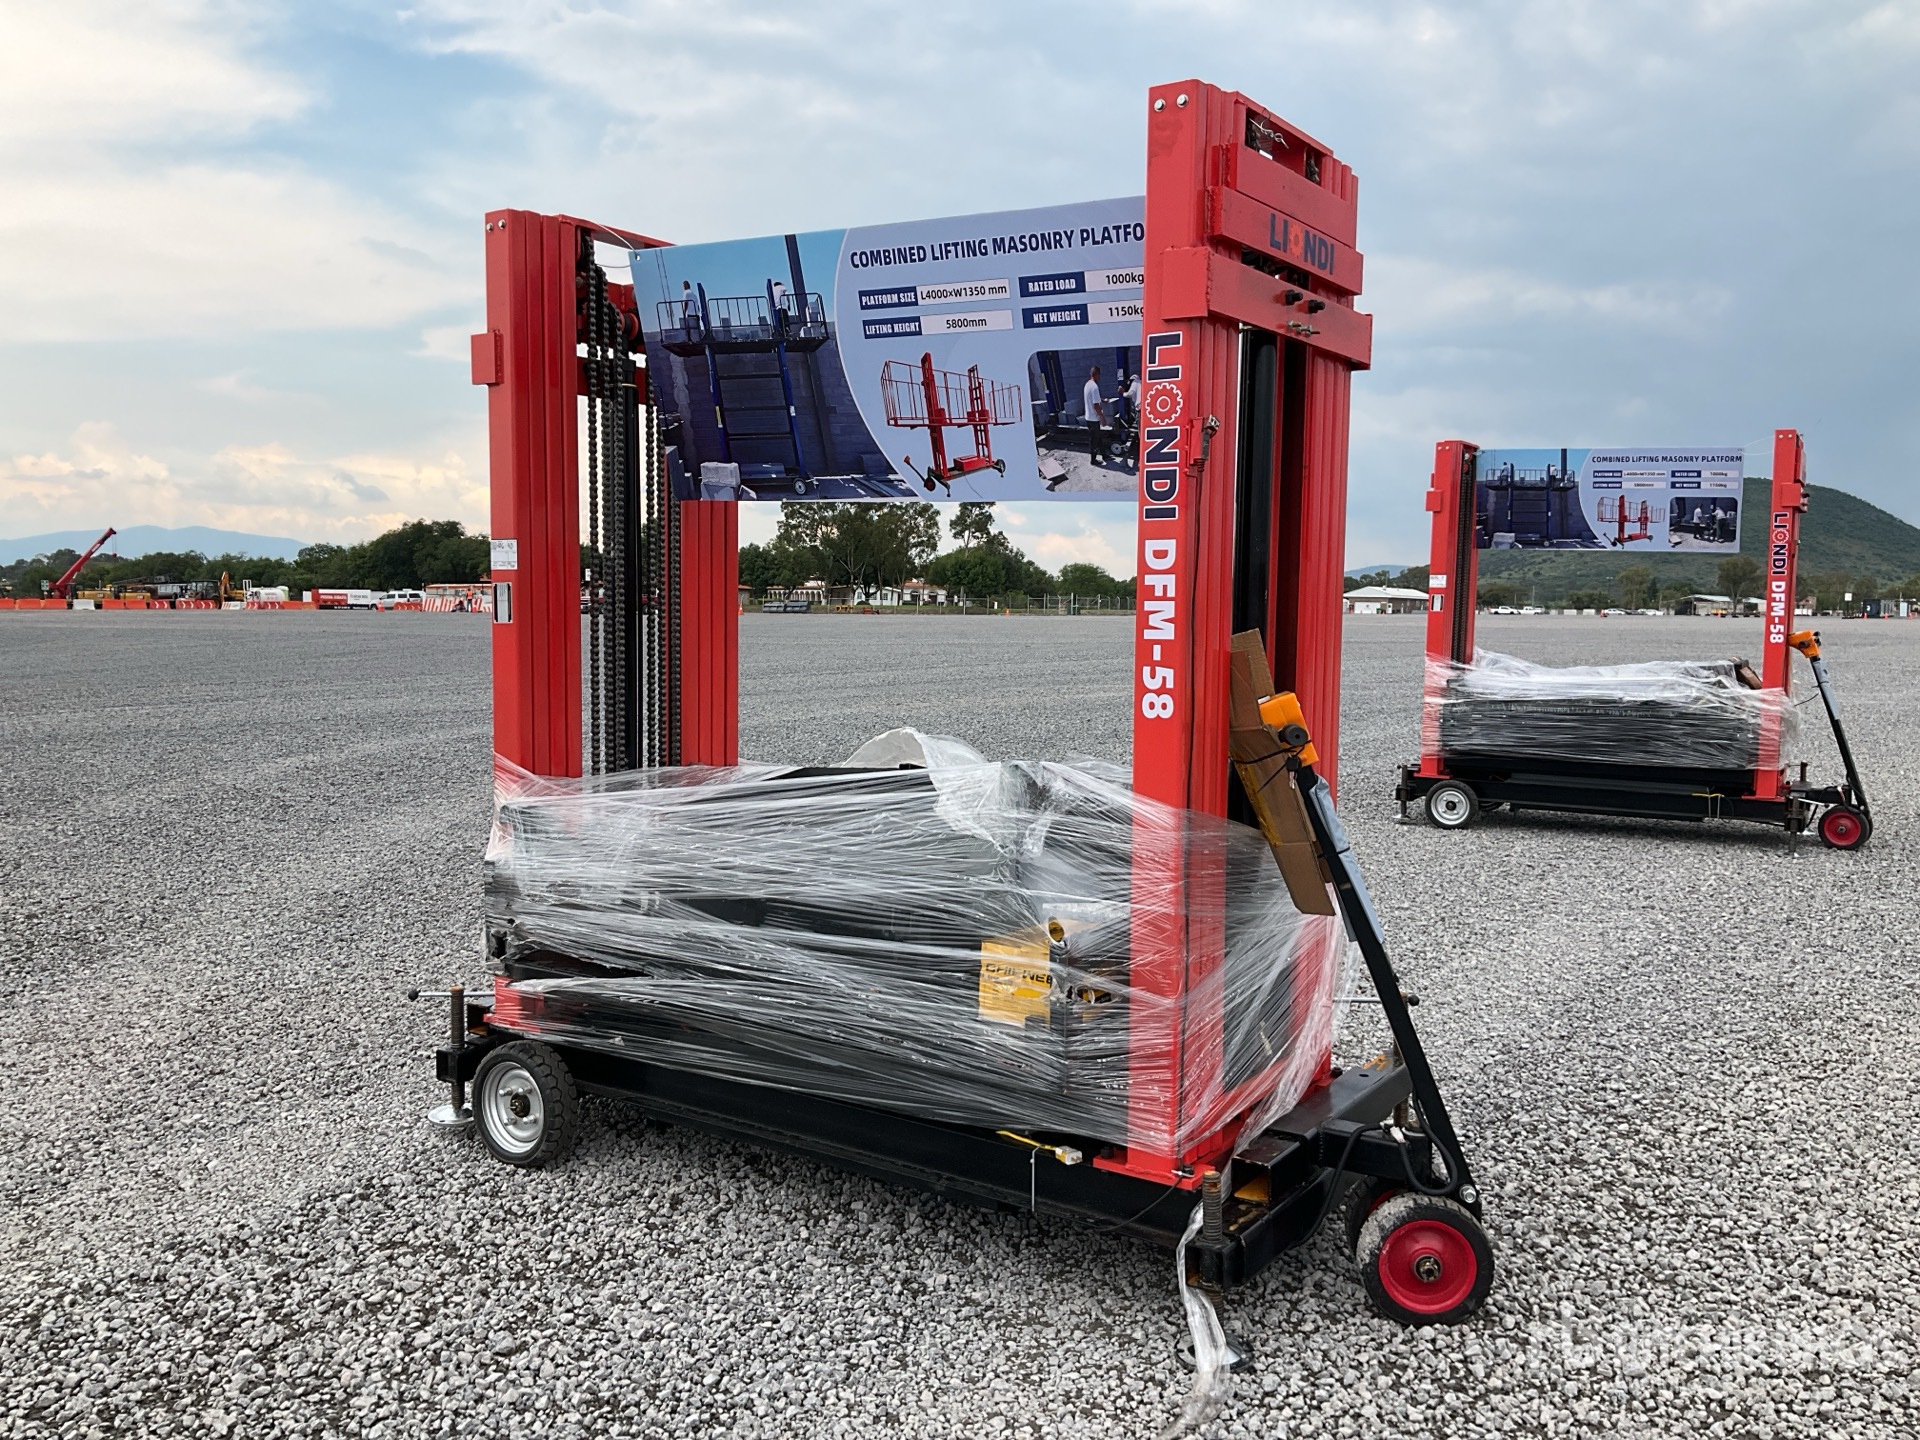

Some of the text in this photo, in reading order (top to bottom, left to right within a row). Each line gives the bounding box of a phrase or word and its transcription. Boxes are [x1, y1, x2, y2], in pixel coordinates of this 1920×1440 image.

[850, 222, 1145, 269] COMBINED LIFTING MASONRY PLATFO
[1270, 213, 1334, 275] LIONDI
[1105, 272, 1144, 285] 1000kg
[988, 285, 1008, 295] mm
[1028, 279, 1076, 292] RATED LOAD
[861, 292, 916, 306] PLATFORM SIZE
[1033, 310, 1081, 324] NET WEIGHT
[1109, 305, 1144, 318] 1150kg
[865, 322, 920, 335] LIFTING HEIGHT
[946, 318, 987, 330] 5800mm
[1592, 455, 1742, 463] COMBINED LIFTING MASONRY PLATFORM
[1141, 331, 1183, 719] LIONDI DFM-58
[1770, 581, 1786, 643] DFM-58
